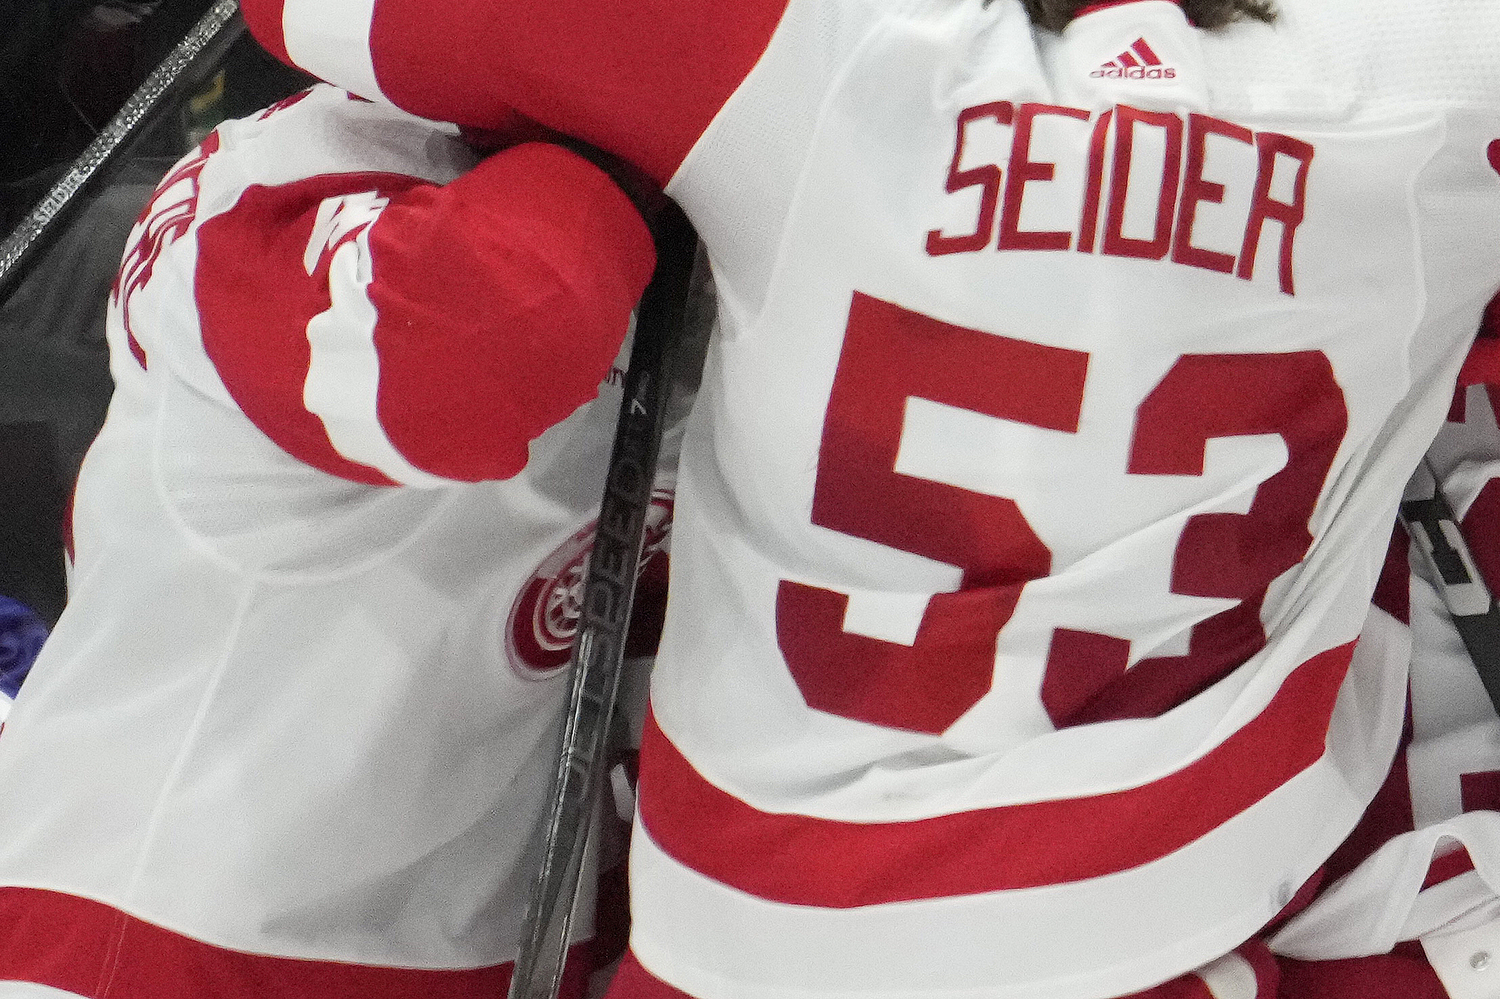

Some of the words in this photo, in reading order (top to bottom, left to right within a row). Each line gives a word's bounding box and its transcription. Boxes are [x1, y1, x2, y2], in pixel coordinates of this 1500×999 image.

[1089, 65, 1176, 80] adidas
[925, 101, 1316, 298] SEIDER
[776, 290, 1350, 737] 53
